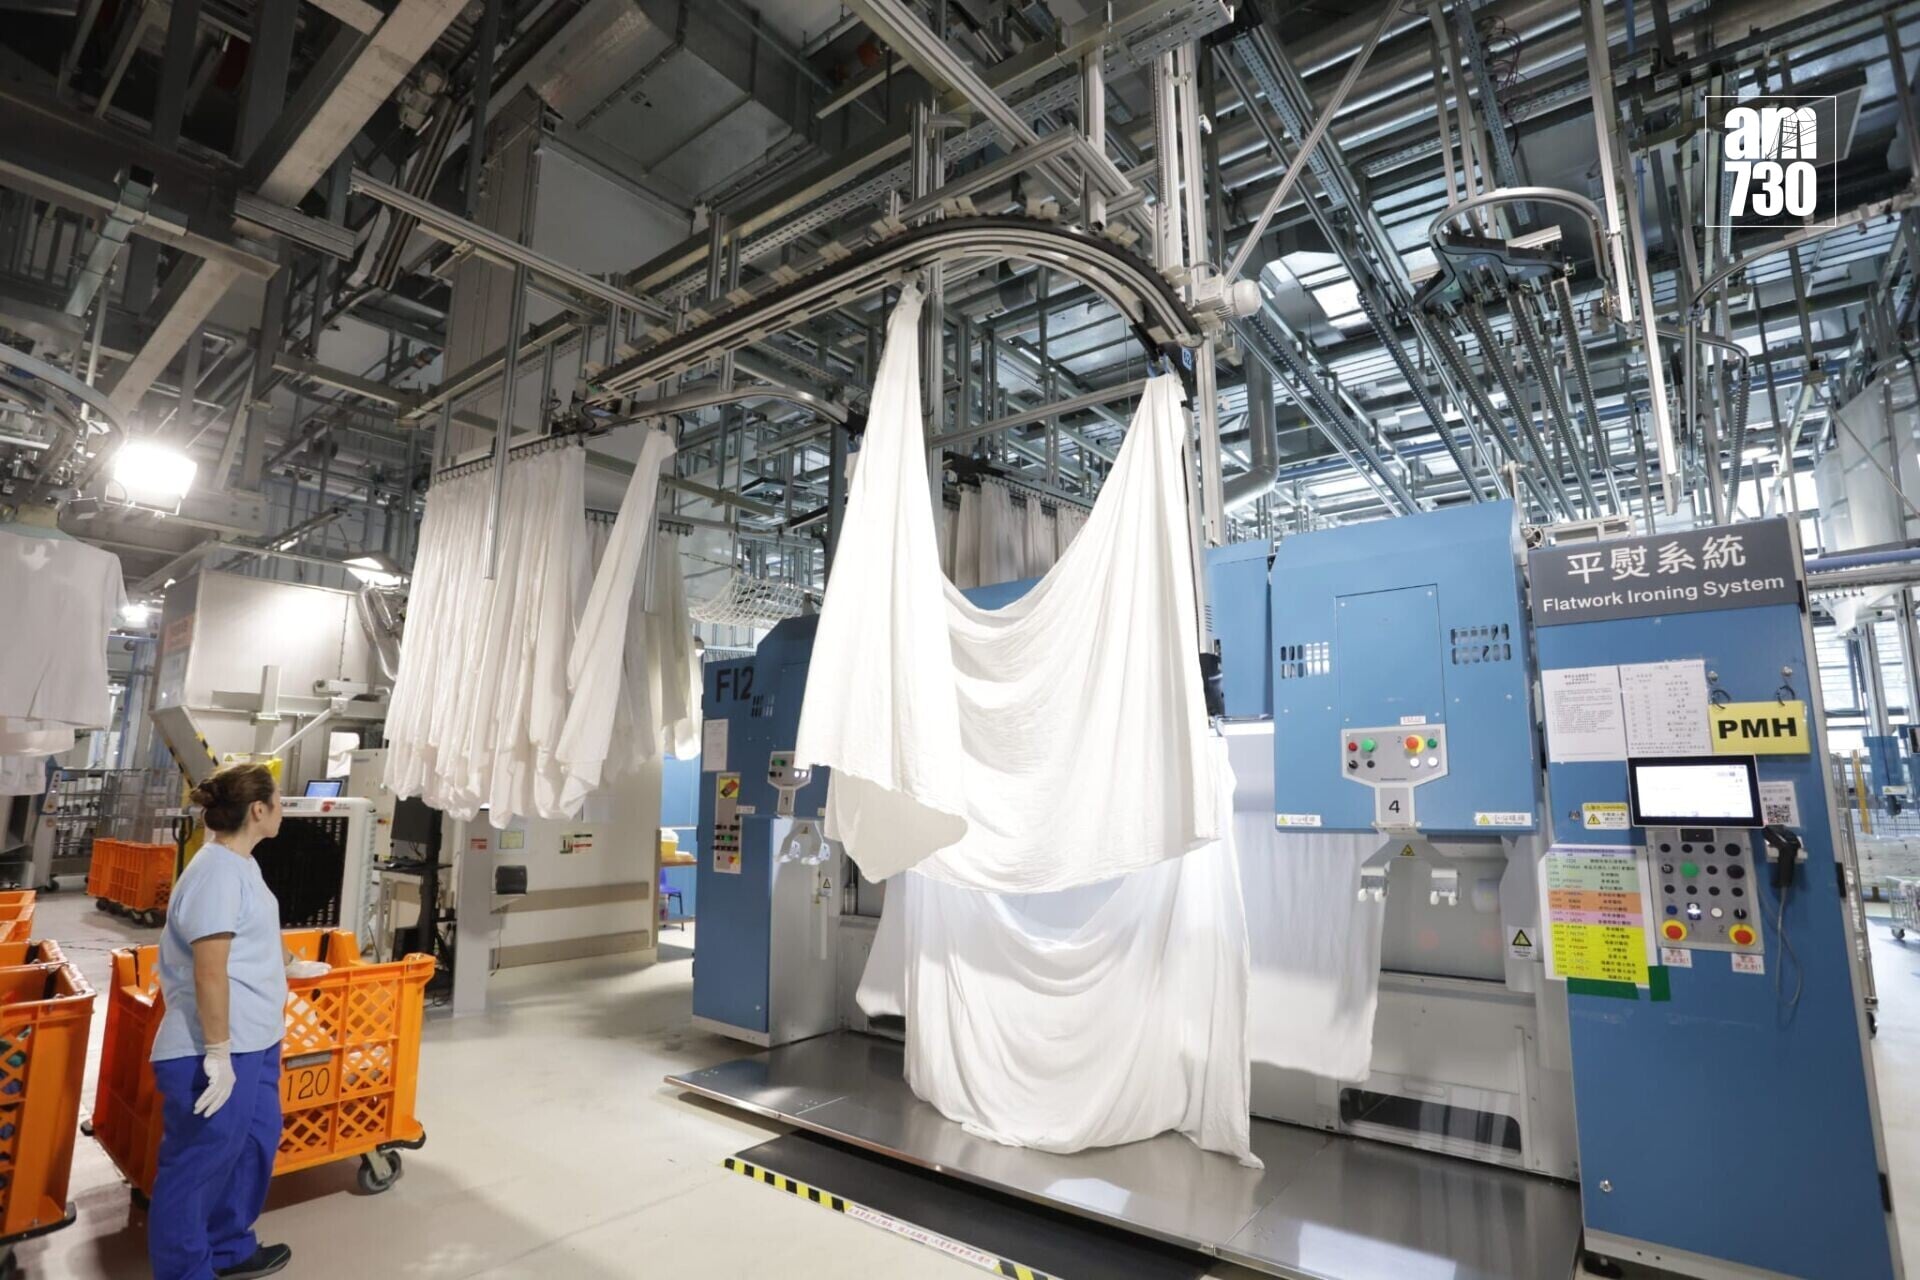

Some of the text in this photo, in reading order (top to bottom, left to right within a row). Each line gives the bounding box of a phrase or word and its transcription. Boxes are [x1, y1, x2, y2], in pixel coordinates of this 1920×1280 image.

[1567, 534, 1747, 585] 平熨系統
[1542, 577, 1785, 613] Flatwork Ironing System
[1718, 717, 1798, 739] PMH
[1388, 799, 1401, 814] 4
[1718, 925, 1725, 933] 2
[286, 1067, 330, 1102] 120
